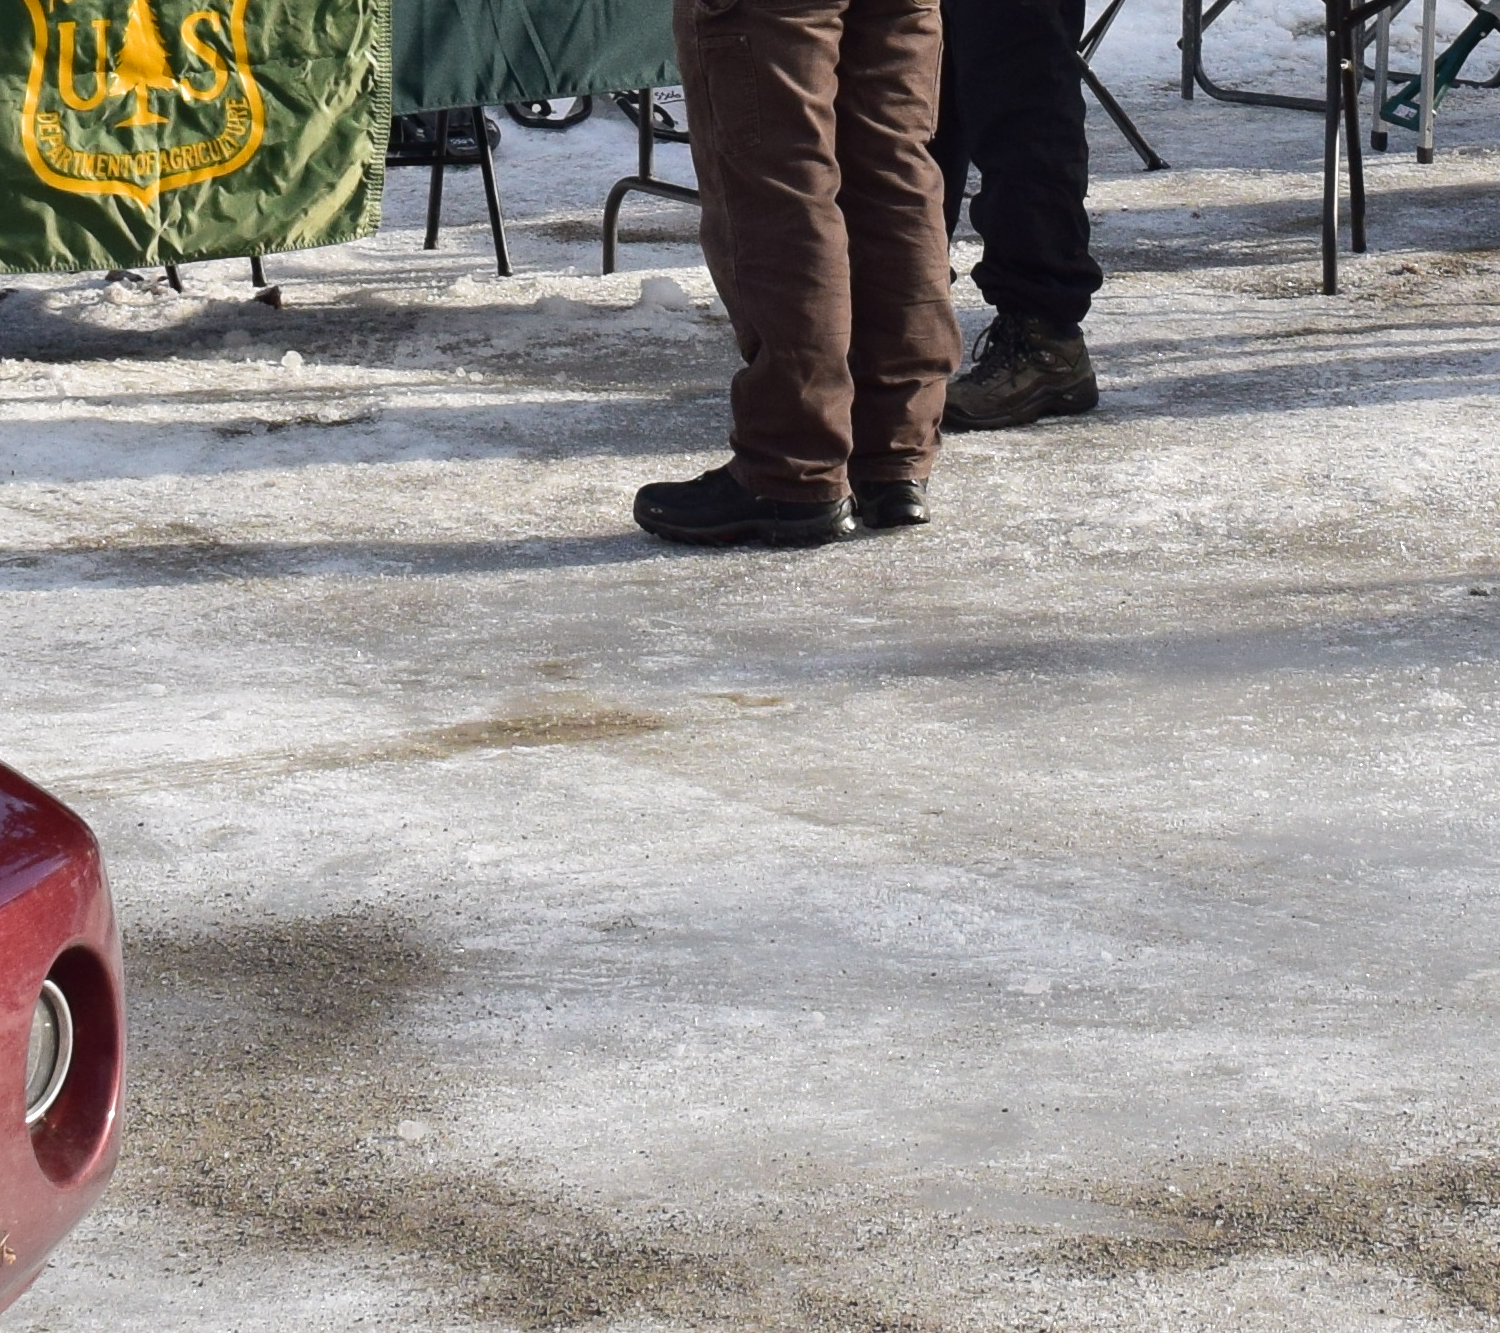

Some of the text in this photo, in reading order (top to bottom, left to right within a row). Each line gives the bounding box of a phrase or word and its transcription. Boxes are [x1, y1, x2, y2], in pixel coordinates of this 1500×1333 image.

[57, 11, 229, 111] U S
[37, 97, 249, 177] DEPARTMENT OF AGRICULTURE
